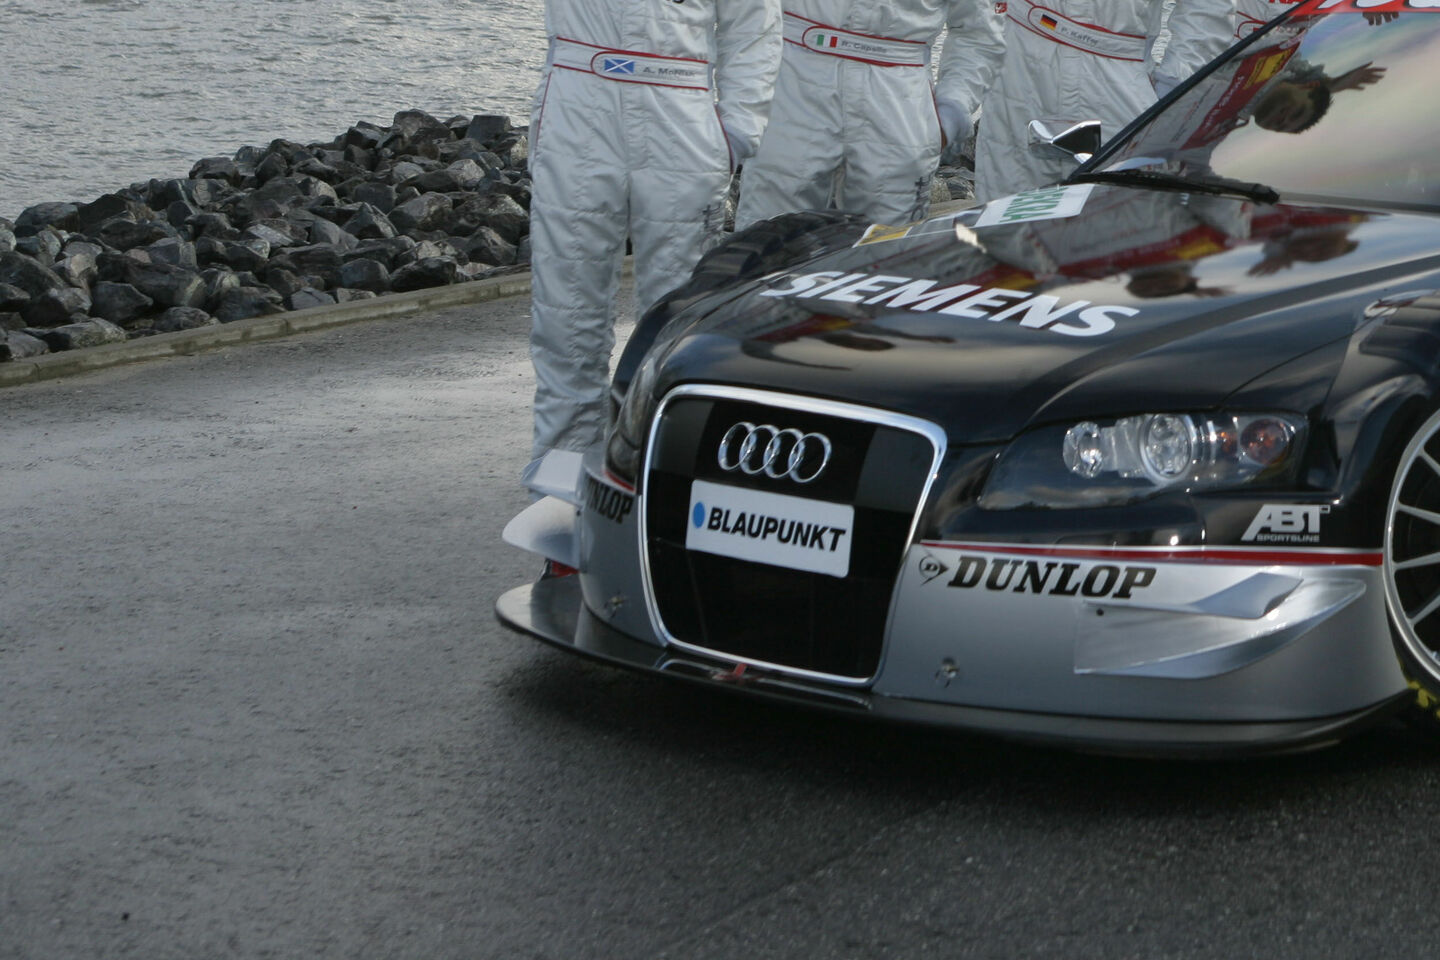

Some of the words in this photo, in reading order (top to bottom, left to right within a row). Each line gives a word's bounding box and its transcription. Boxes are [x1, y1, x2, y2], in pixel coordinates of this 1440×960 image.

[761, 270, 1140, 337] SIEMENS
[707, 507, 846, 553] BLAUPUNKT
[1241, 504, 1330, 541] ABT
[948, 556, 1156, 600] DUNLOP
